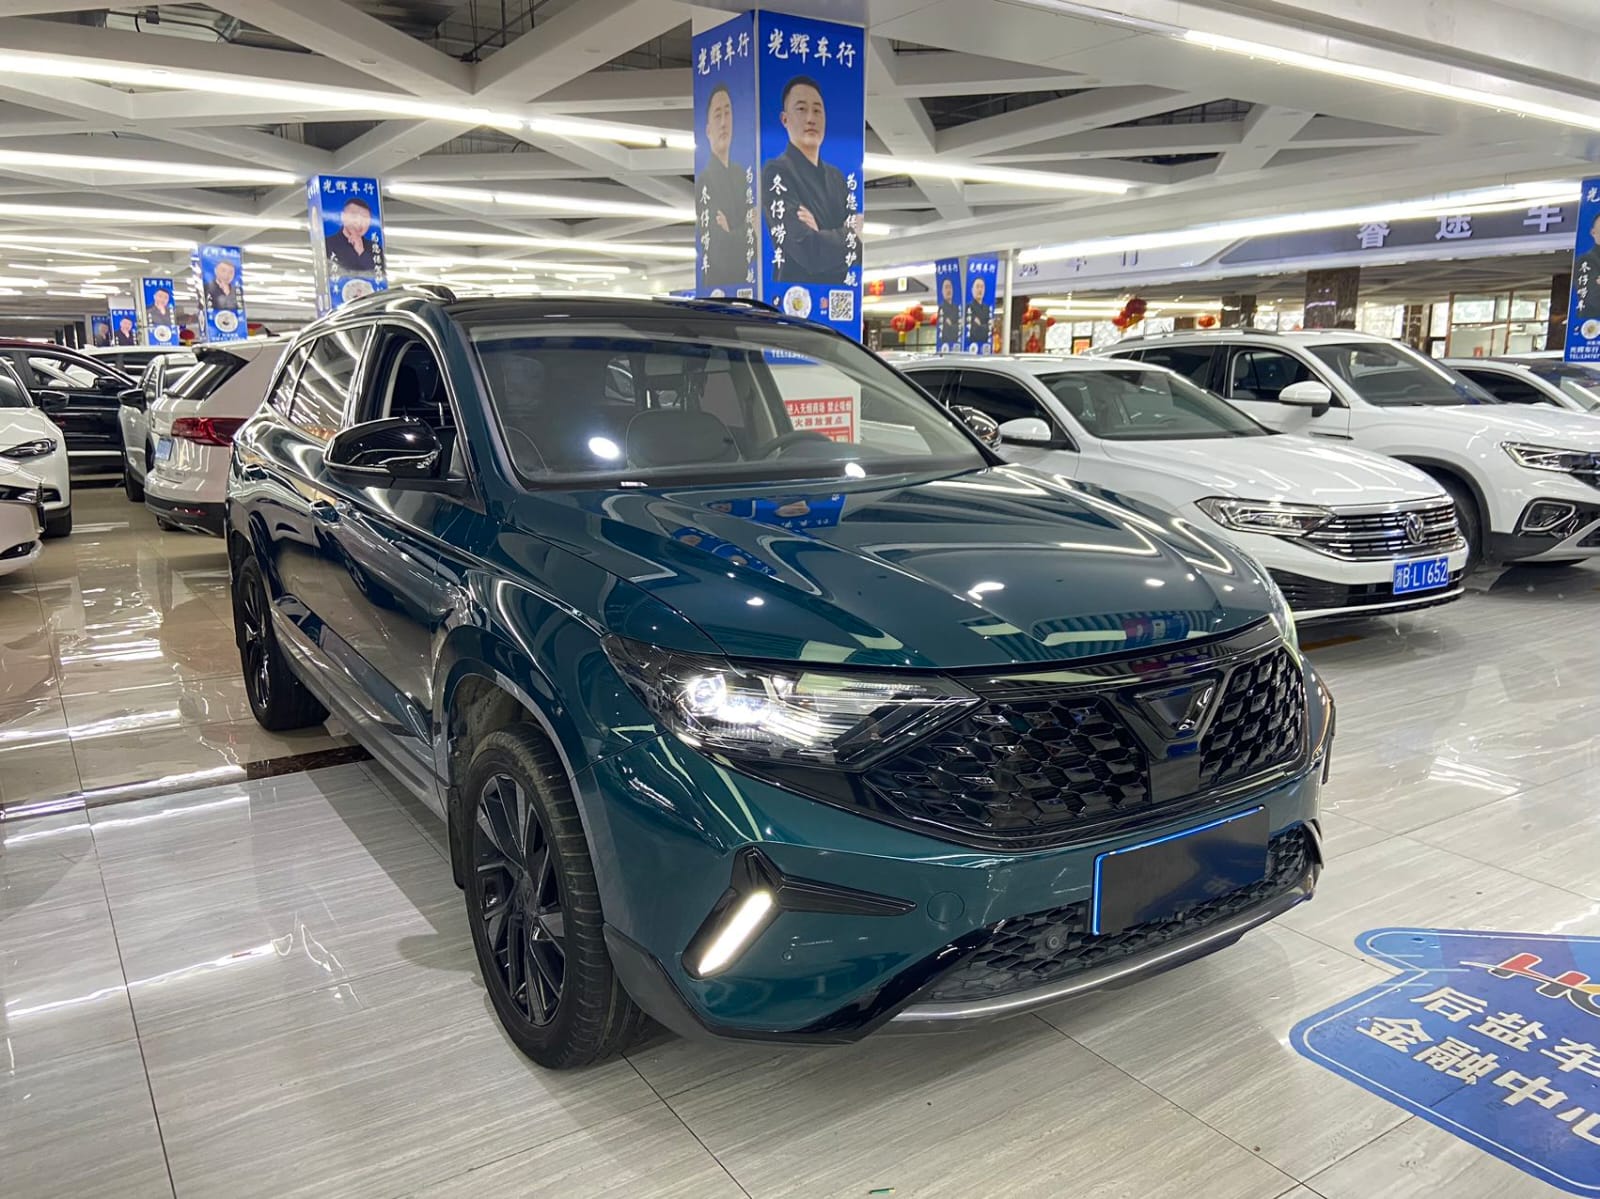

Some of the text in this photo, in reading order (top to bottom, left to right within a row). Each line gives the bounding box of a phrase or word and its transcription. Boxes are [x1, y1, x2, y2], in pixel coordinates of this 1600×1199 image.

[697, 32, 750, 75] 光辉车行
[768, 28, 856, 68] 光辉车行
[323, 180, 375, 196] 光辉车行
[769, 173, 788, 269] 冬仔唠车
